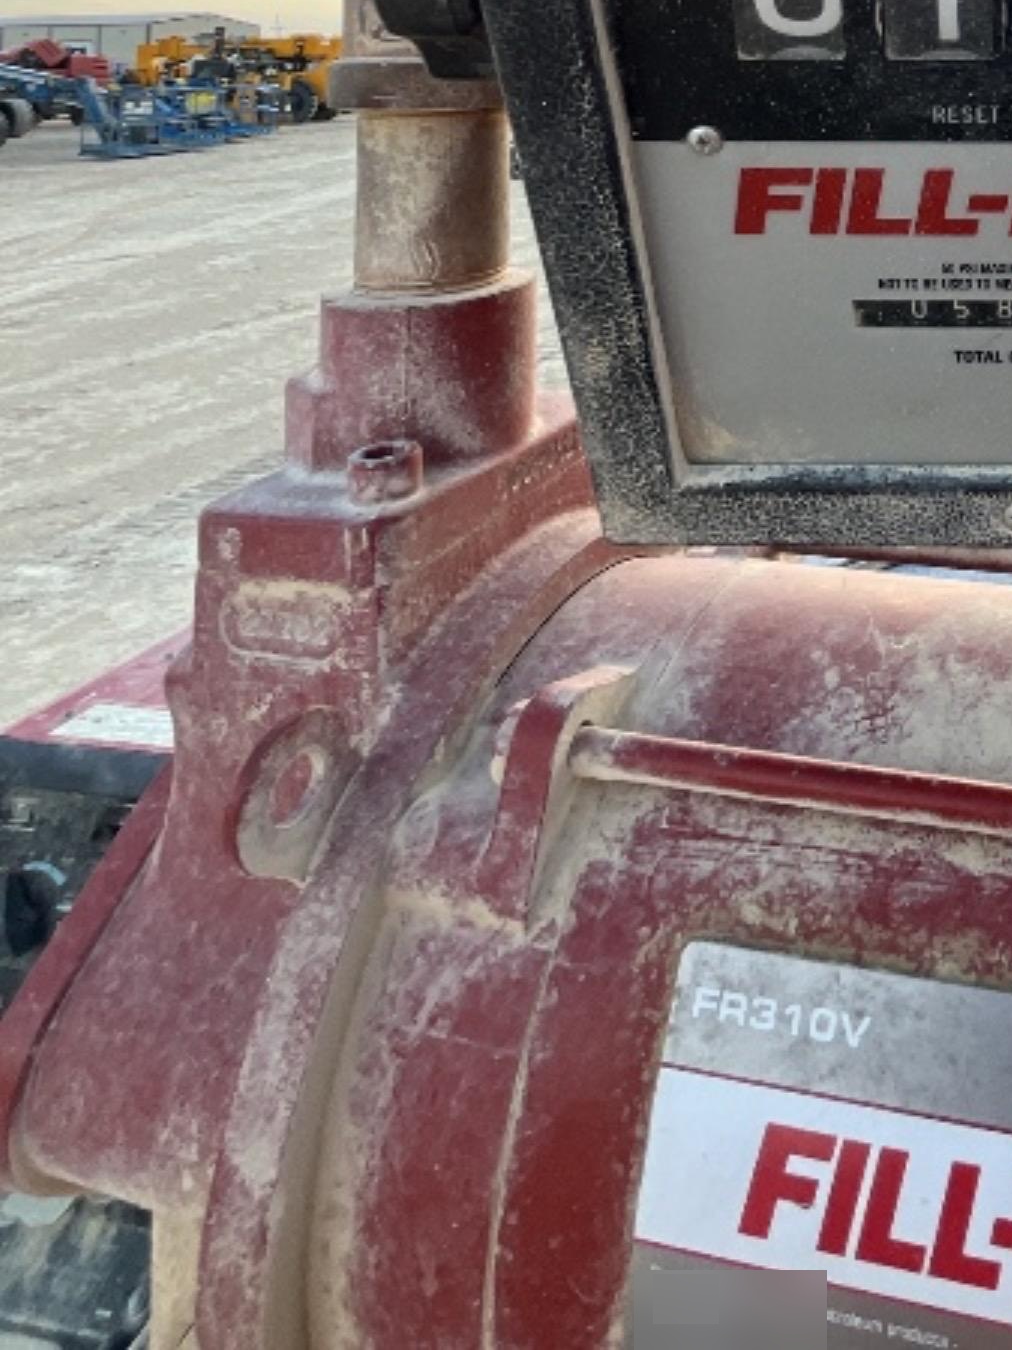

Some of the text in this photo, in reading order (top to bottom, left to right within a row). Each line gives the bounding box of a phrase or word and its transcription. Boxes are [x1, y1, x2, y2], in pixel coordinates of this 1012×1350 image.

[932, 105, 999, 125] RESET
[954, 350, 1003, 364] TOTAL
[691, 987, 873, 1049] FR310V
